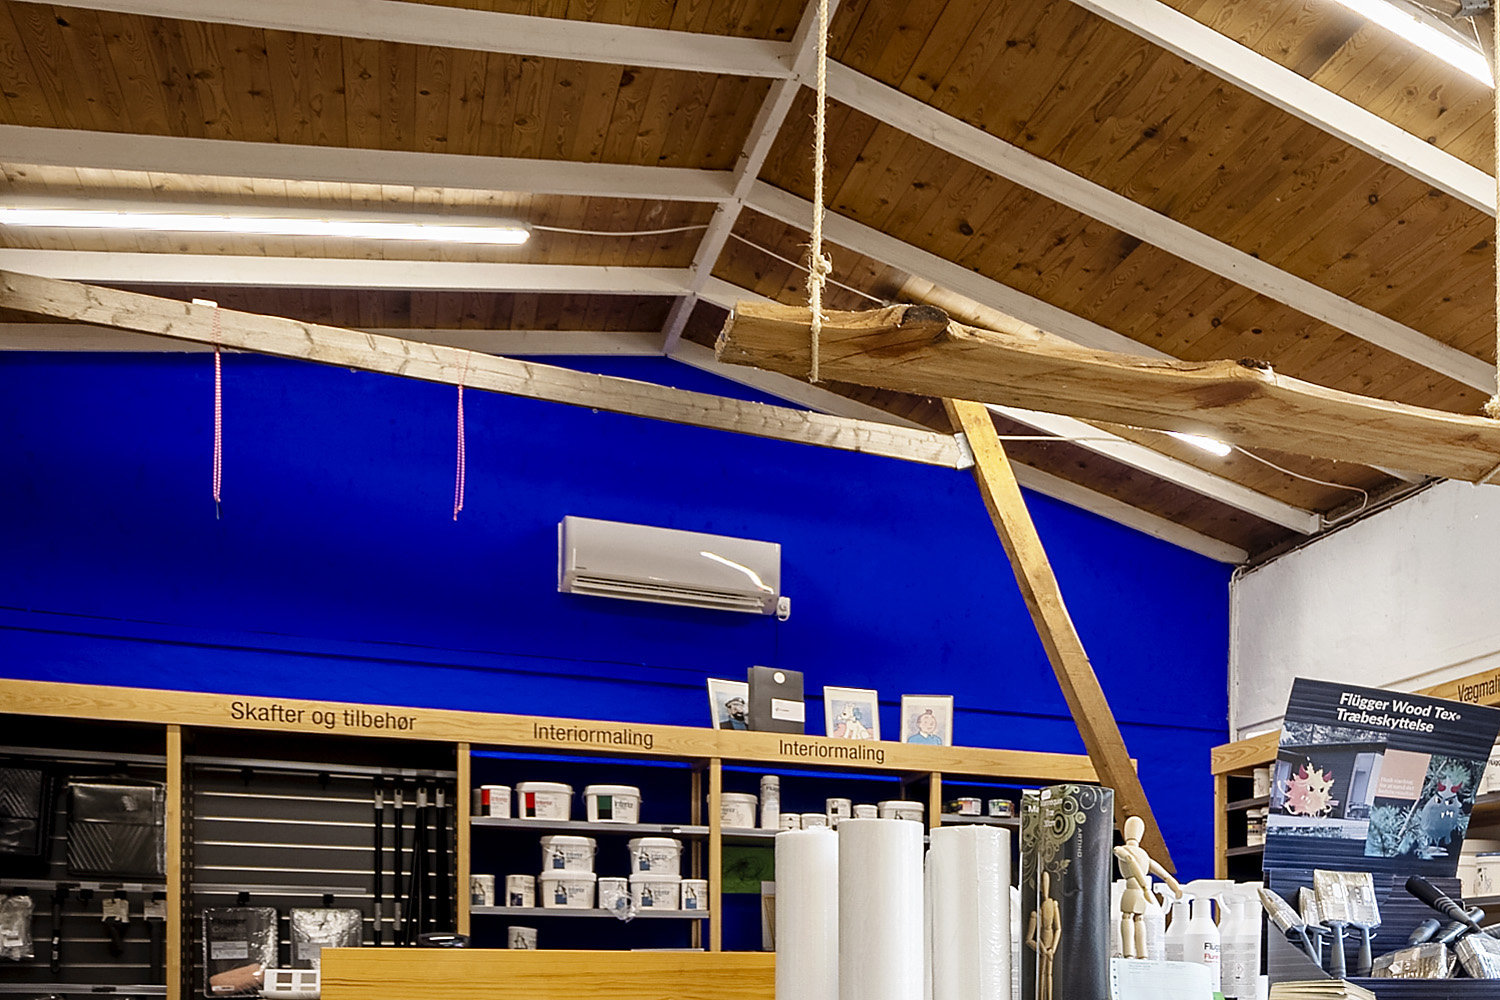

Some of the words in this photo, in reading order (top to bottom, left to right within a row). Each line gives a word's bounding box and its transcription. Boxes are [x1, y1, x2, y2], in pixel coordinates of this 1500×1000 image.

[230, 701, 305, 725] Skafter
[312, 710, 336, 729] og
[343, 709, 418, 731] tilbehør
[1339, 692, 1389, 712] Flügger
[1392, 700, 1432, 717] Wood
[1336, 707, 1435, 733] Træbeskyttelse
[533, 722, 655, 750] Interiormaling
[779, 739, 885, 765] Interiormaling
